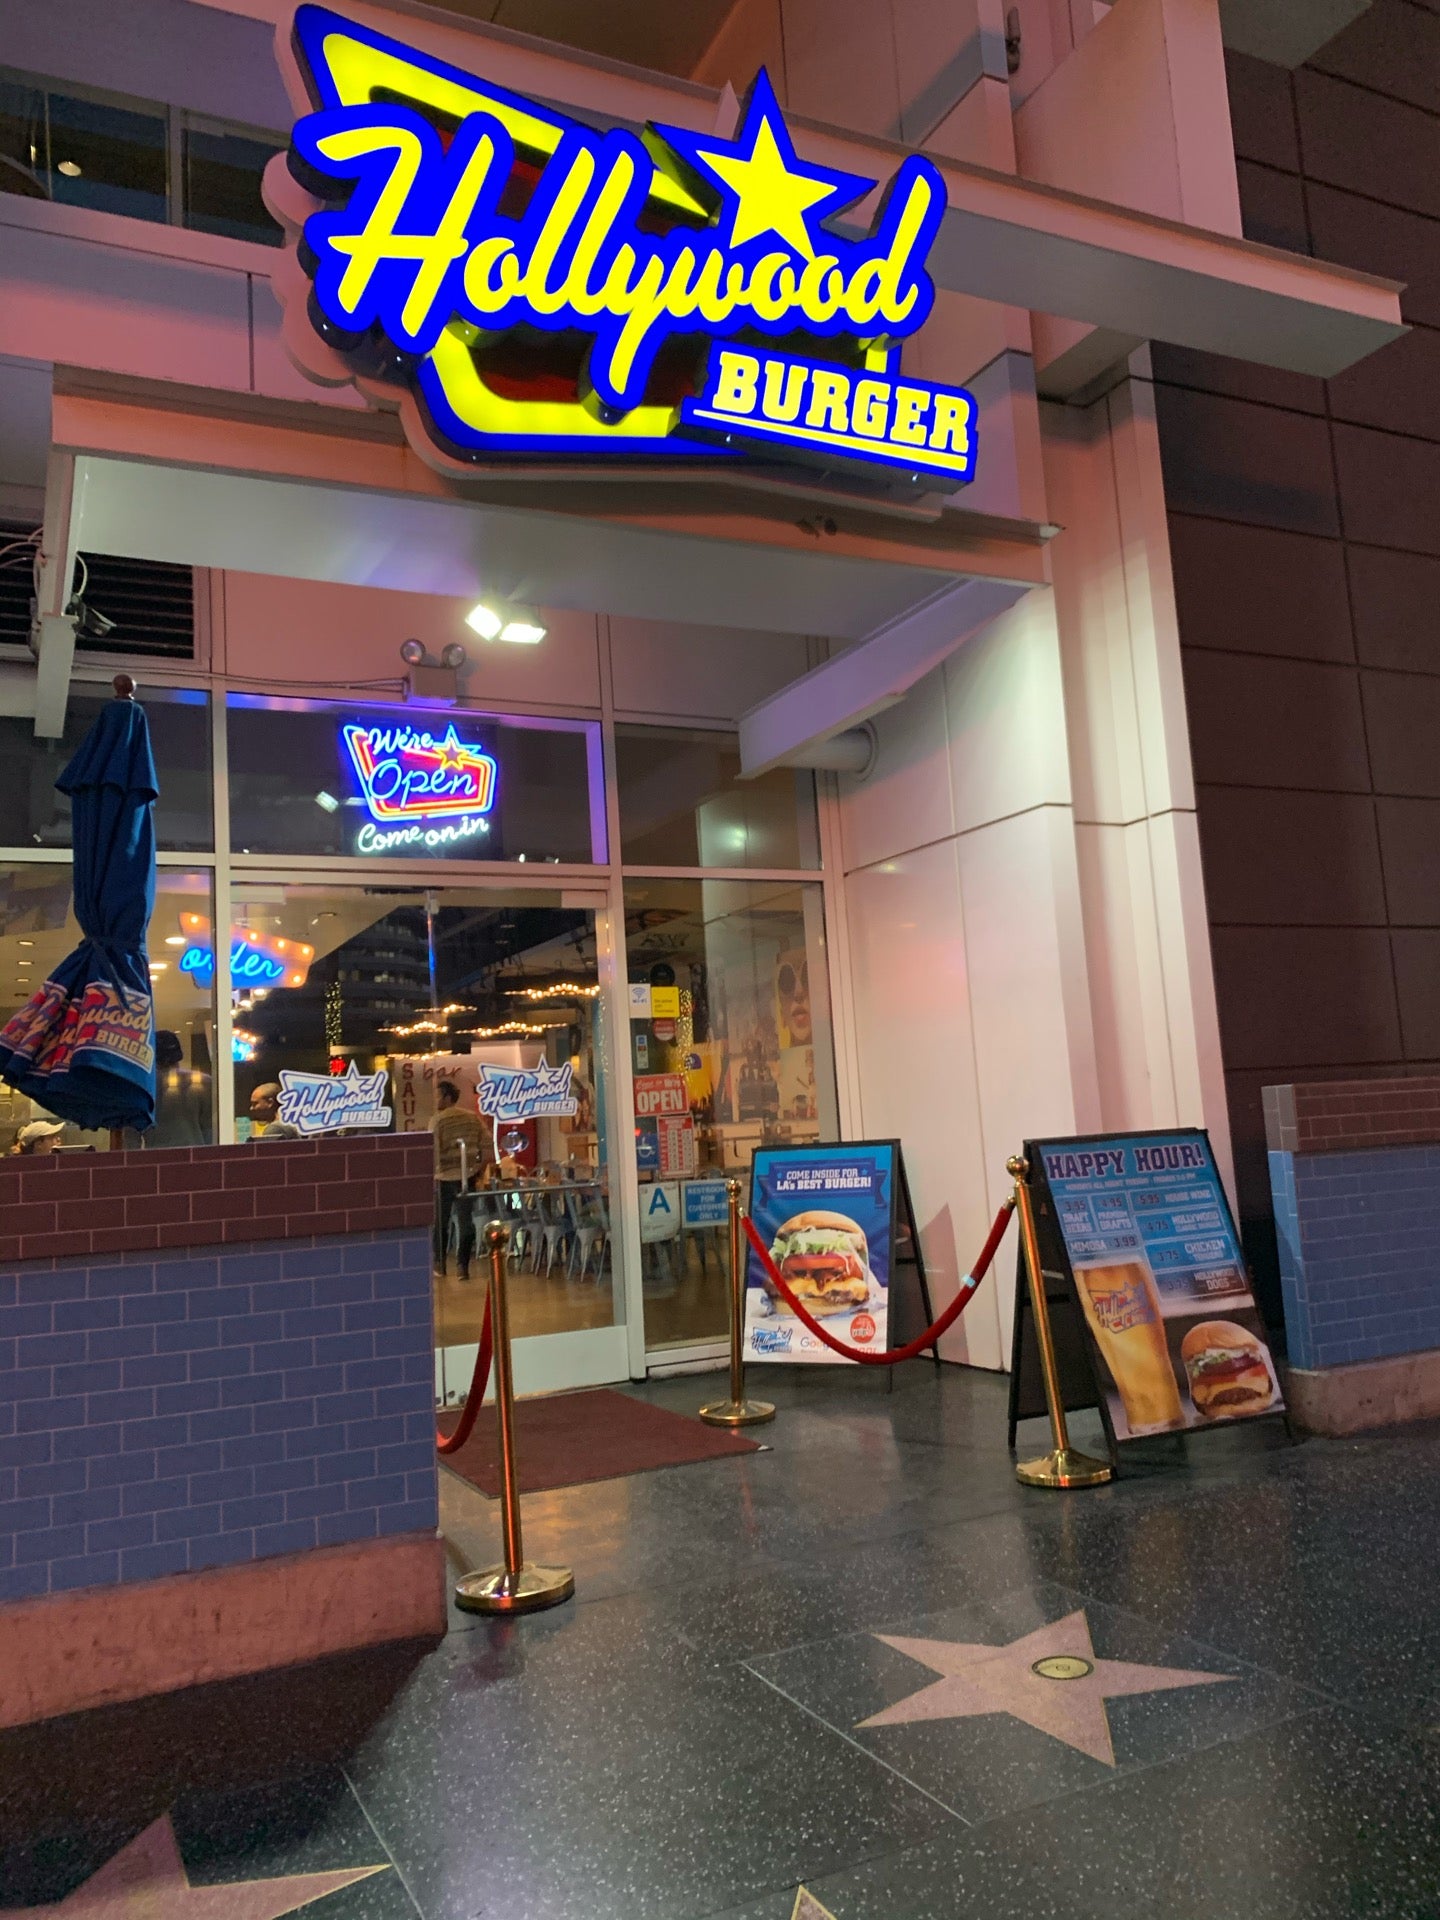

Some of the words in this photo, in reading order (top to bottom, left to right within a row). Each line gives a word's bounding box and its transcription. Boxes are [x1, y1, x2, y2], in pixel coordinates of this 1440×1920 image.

[315, 125, 932, 396] Hollywood
[713, 352, 972, 453] BURGER
[369, 725, 434, 756] We're
[368, 758, 478, 809] Open
[358, 822, 424, 852] Come
[422, 1062, 462, 1081] bar
[281, 1073, 384, 1124] Hollywood
[480, 1065, 571, 1114] Hollywood
[637, 1089, 683, 1113] OPEN
[341, 1110, 387, 1123] BURGER
[535, 1101, 575, 1112] BURGER
[786, 1170, 810, 1180] COME
[811, 1168, 840, 1179] INSIDE
[842, 1168, 858, 1177] FOR
[1046, 1151, 1125, 1179] HAPPY
[1135, 1143, 1205, 1172] HOUR!
[797, 1179, 823, 1190] BEST
[825, 1176, 872, 1189] BURGER!
[649, 1187, 671, 1215] A
[1184, 1239, 1225, 1254] CHICKEN
